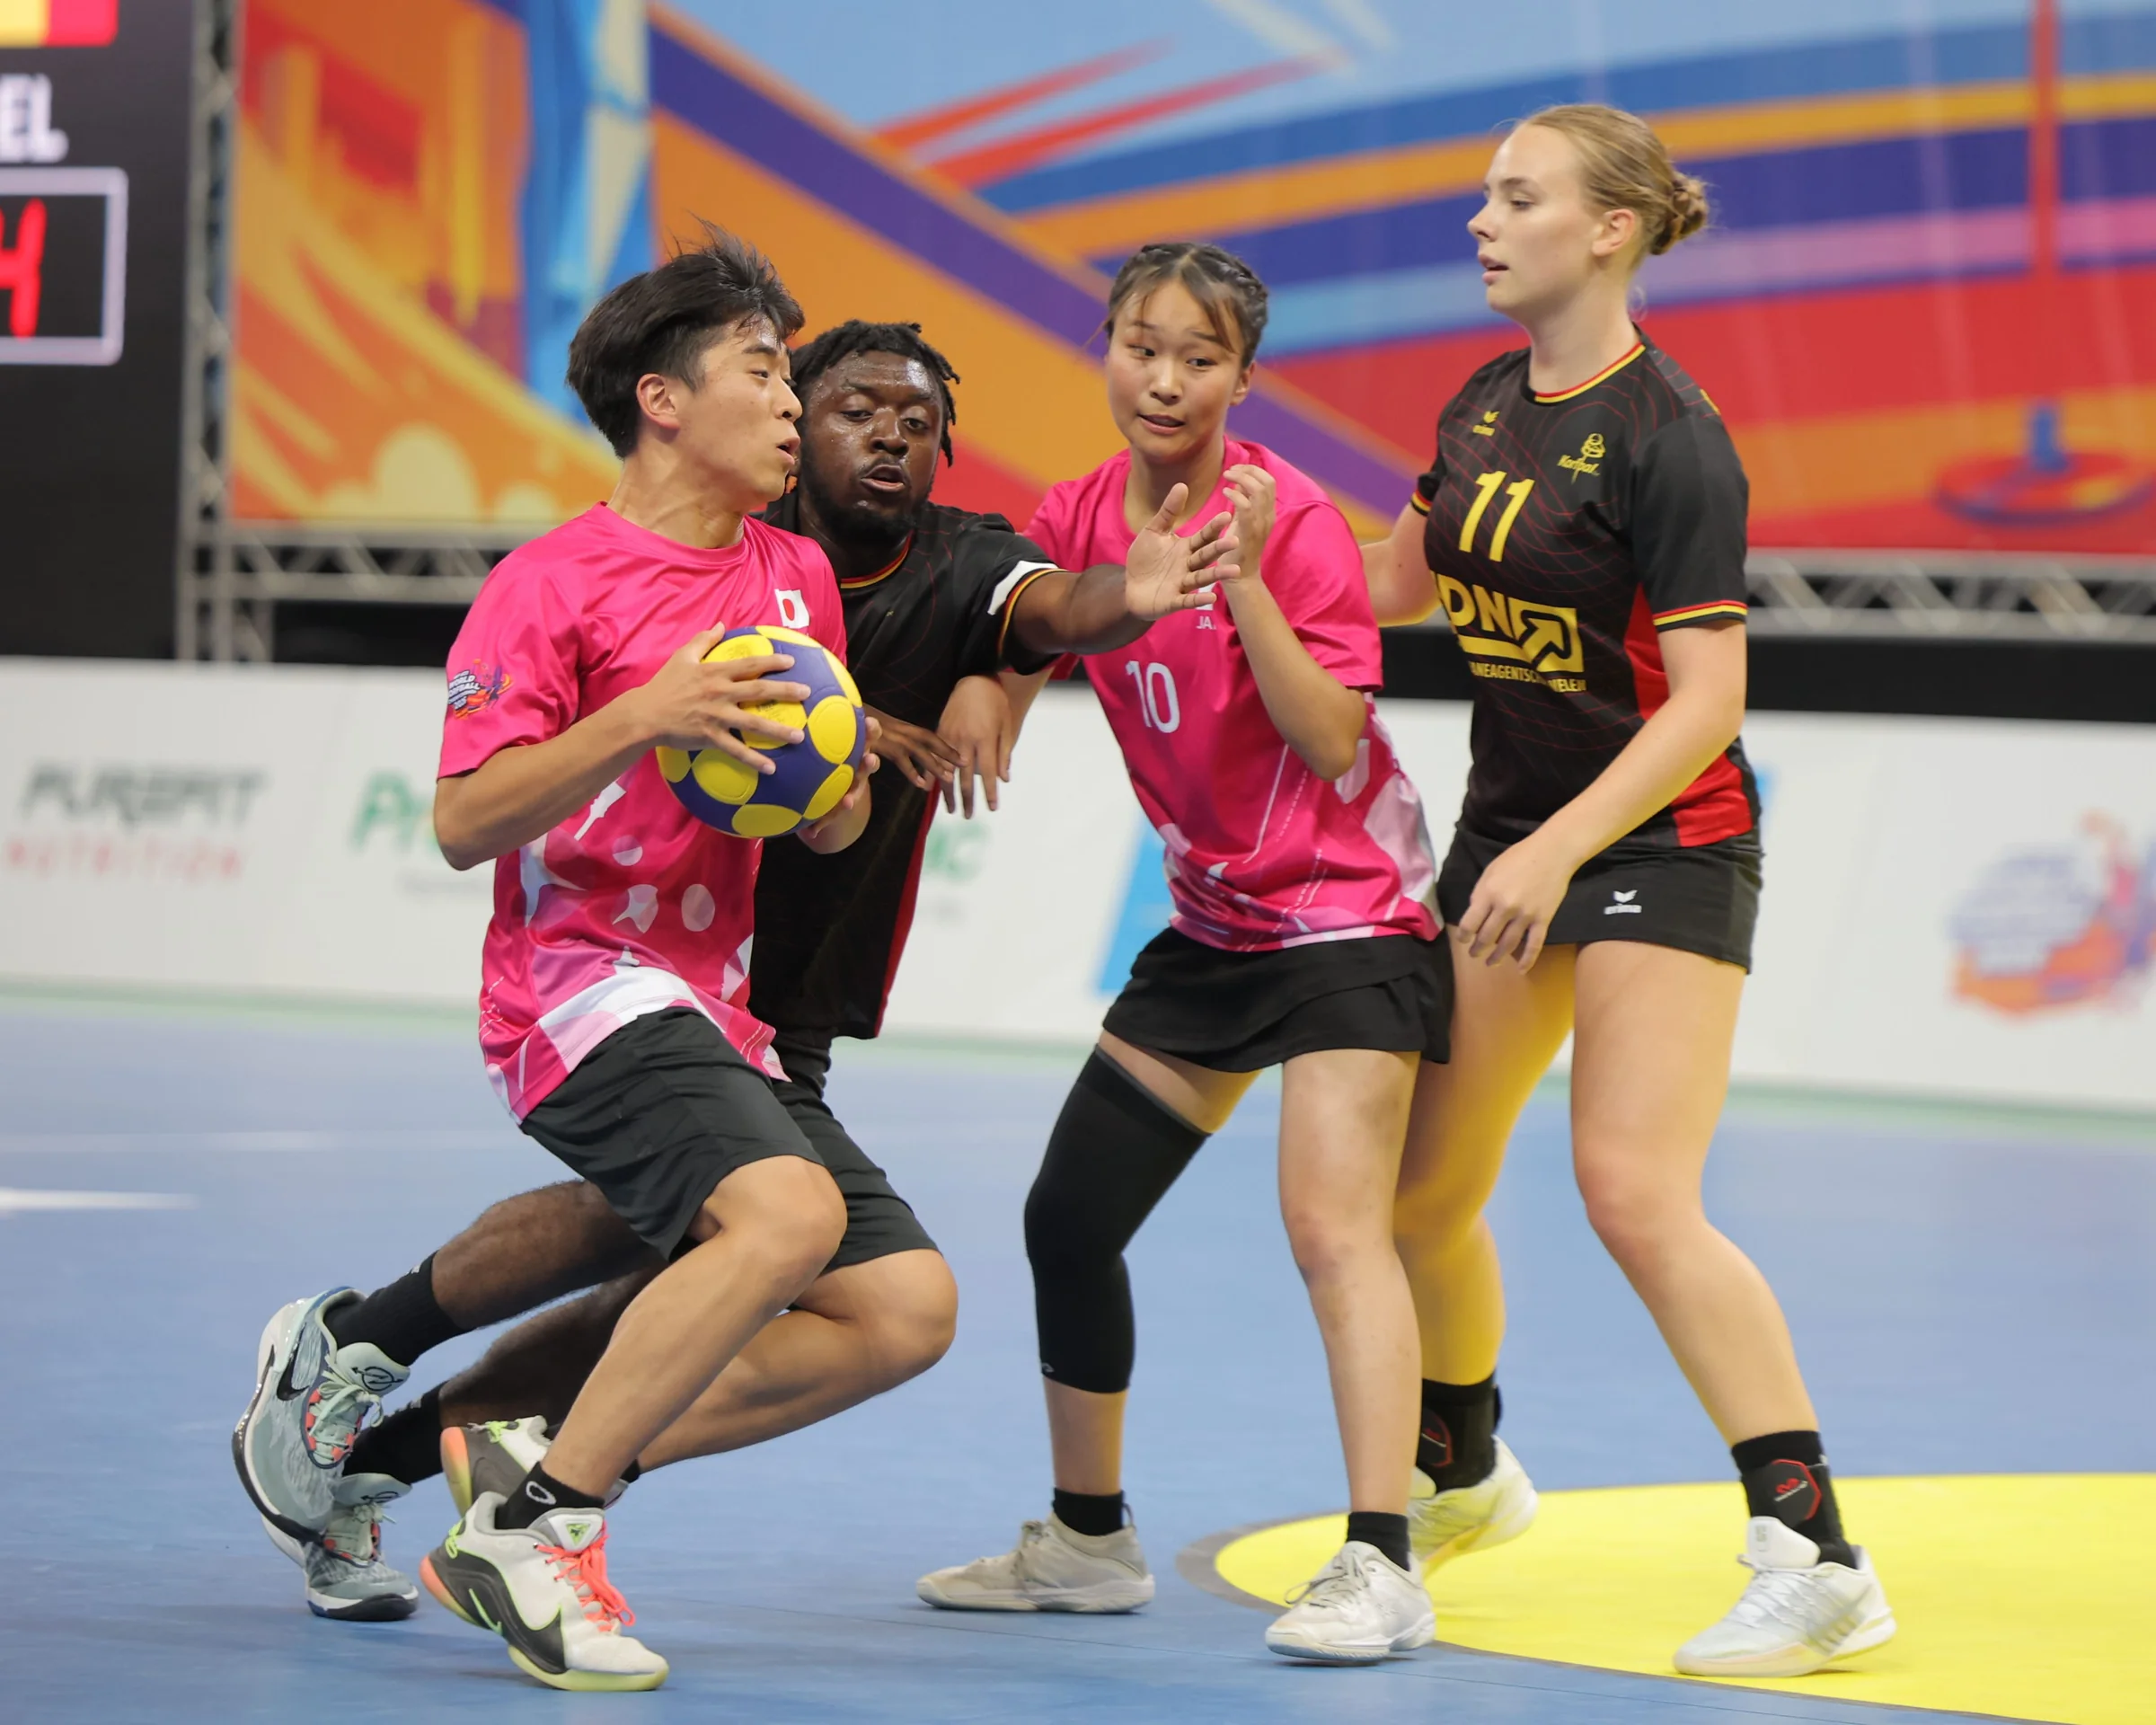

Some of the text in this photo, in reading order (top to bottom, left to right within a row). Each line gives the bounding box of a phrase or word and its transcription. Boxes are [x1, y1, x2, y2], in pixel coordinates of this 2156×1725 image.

[1459, 471, 1535, 562] 11
[1196, 615, 1217, 630] JA
[1126, 660, 1180, 733] 10
